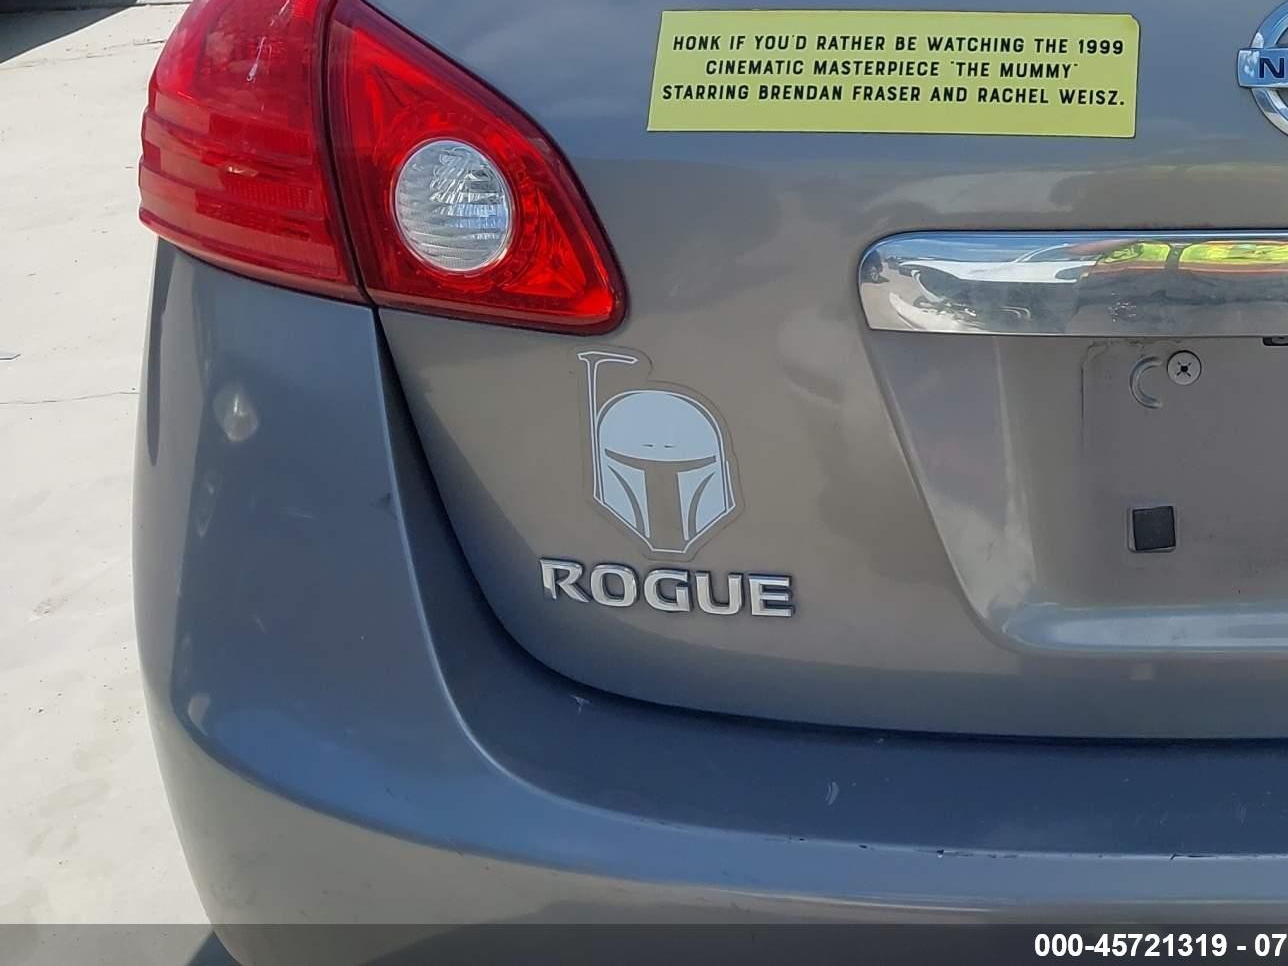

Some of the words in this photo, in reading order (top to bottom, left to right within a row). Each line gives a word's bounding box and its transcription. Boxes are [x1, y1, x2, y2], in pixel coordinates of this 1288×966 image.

[672, 35, 721, 51] HONK
[730, 35, 746, 50] IF
[755, 34, 807, 51] YOU'D
[816, 36, 885, 51] RATHER
[895, 37, 917, 51] BE
[927, 37, 1025, 53] WATCHING
[1034, 38, 1068, 53] THE
[1078, 39, 1123, 55] 1999
[706, 60, 804, 75] CINEMATIC
[813, 60, 940, 76] MASTERPIECE
[662, 85, 749, 100] STARRING
[758, 85, 842, 100] BRENDAN
[852, 86, 921, 102] FRASER
[930, 87, 967, 102] AND
[977, 87, 1049, 104] RACHEL
[1059, 89, 1125, 105] WEISZ.
[540, 558, 794, 617] ROGUE
